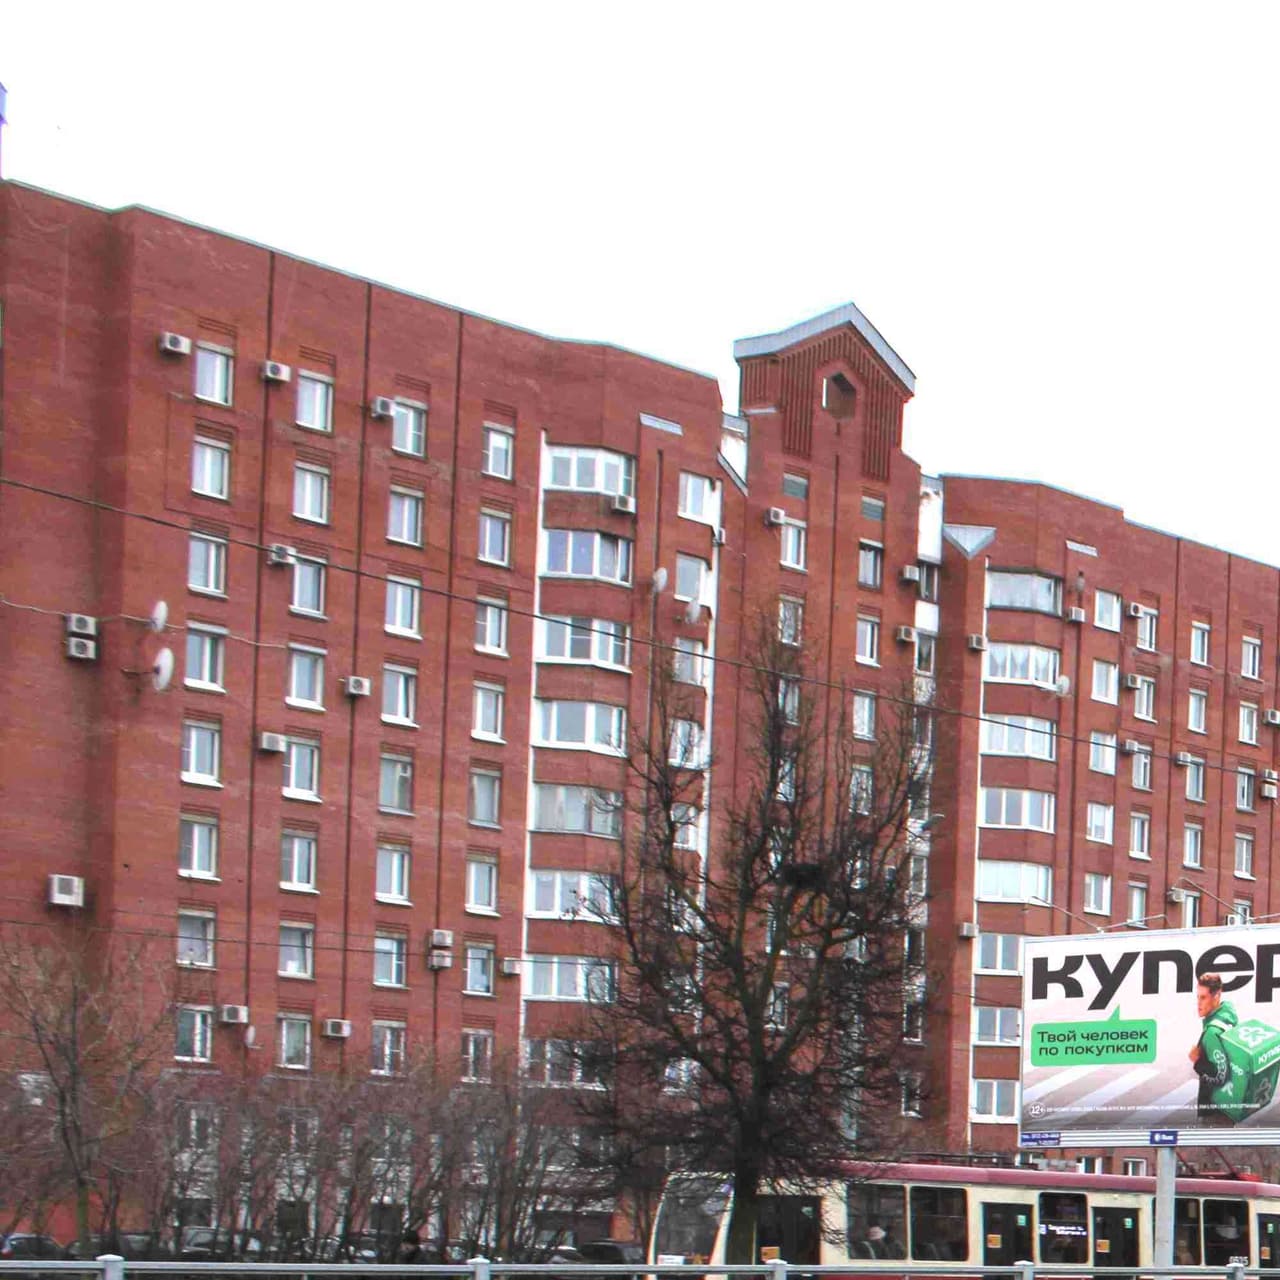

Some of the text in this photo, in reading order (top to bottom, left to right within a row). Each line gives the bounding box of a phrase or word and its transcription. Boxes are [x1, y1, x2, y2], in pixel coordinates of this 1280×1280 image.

[1037, 1030, 1149, 1043] Твой человек
[1039, 1043, 1149, 1056] по покупкам
